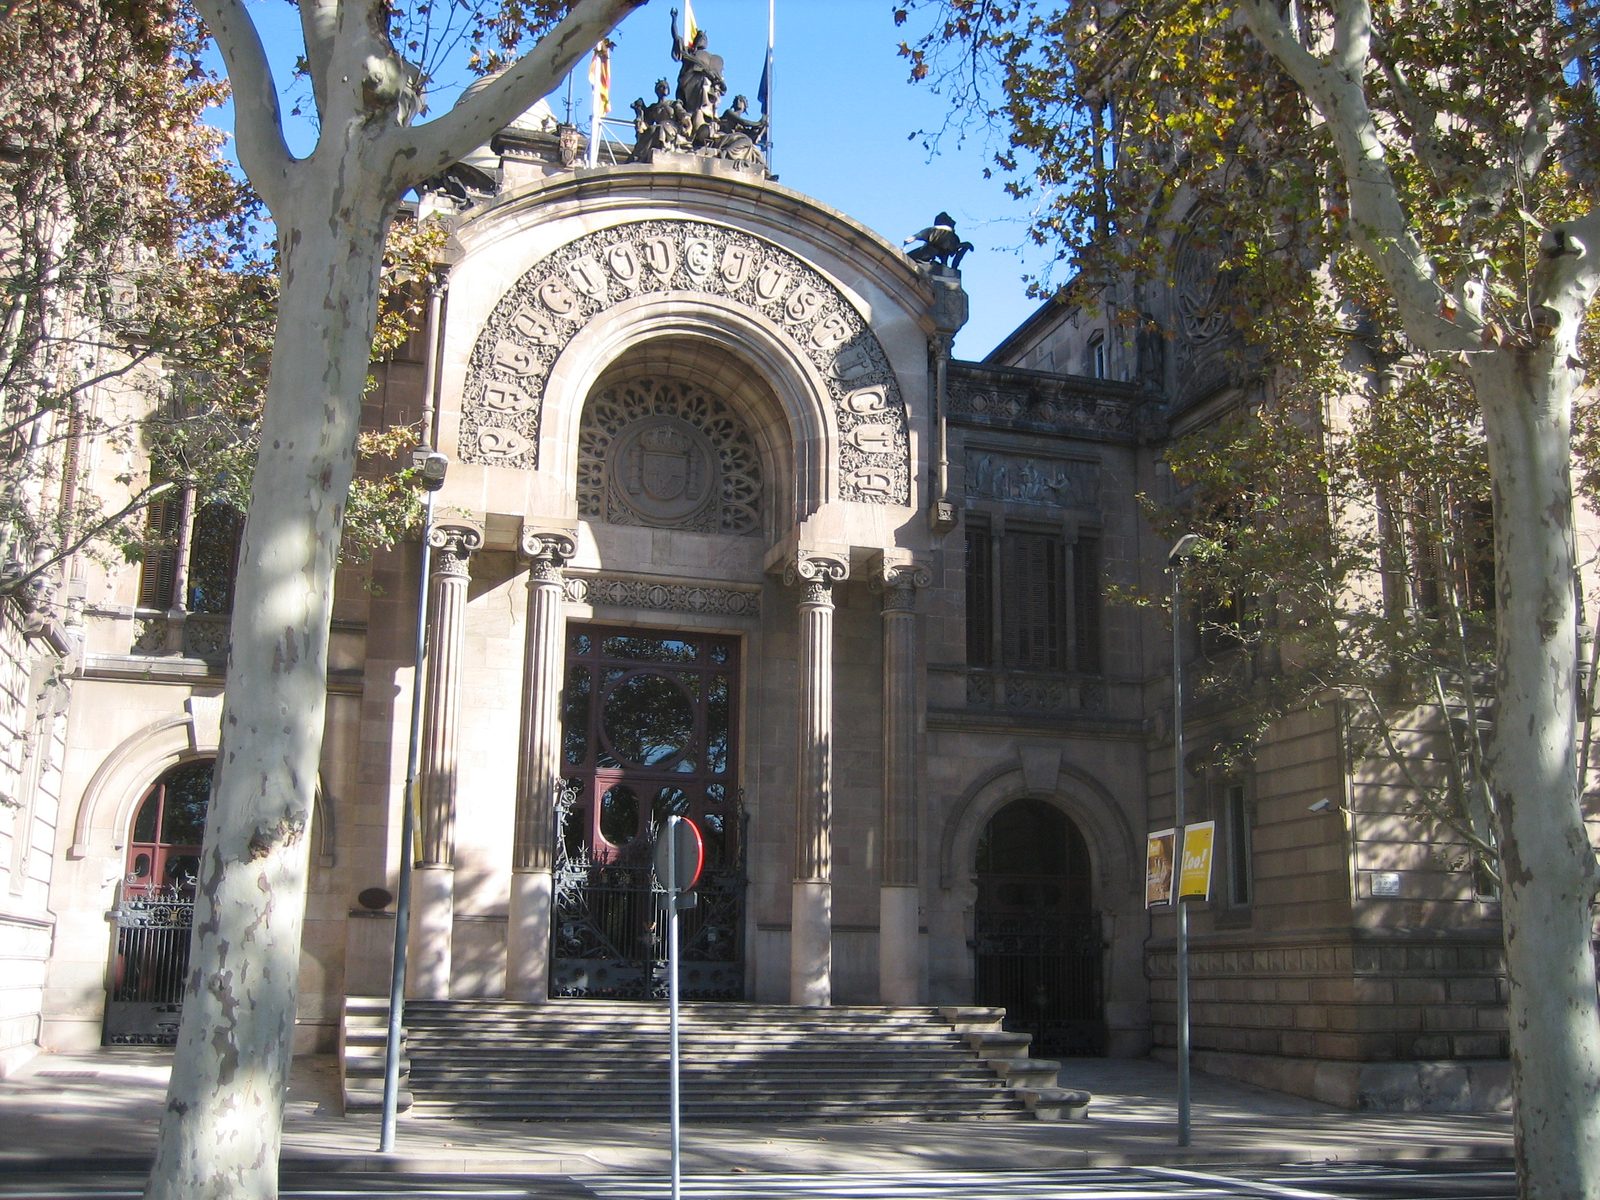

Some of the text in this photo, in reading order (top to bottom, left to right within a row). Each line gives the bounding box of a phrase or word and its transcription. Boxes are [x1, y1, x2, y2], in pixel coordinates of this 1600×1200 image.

[477, 238, 894, 496] PALACIO DE JUSTICIA
